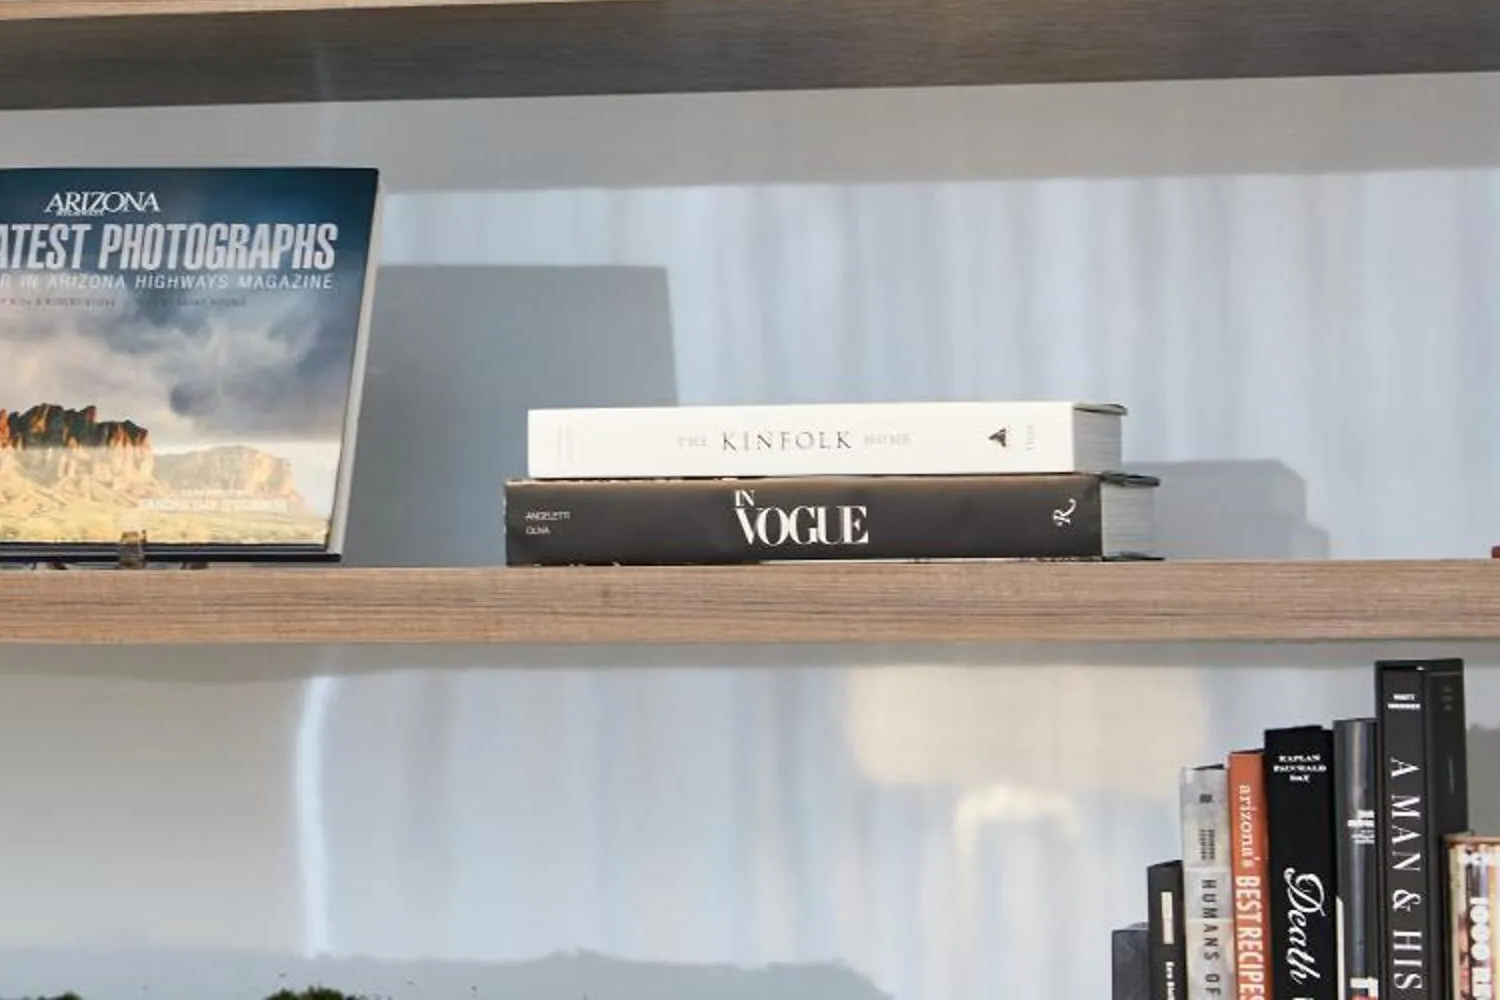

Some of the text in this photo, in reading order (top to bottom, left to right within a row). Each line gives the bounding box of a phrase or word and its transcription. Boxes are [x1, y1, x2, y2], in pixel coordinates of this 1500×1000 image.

[43, 191, 161, 213] ARIZONA
[97, 222, 339, 271] PHOTOGRAPHS
[20, 274, 39, 289] IN
[46, 273, 126, 290] ARIZONA
[134, 274, 229, 290] HIGHWAYS
[238, 273, 334, 290] MAGAZINE
[722, 431, 852, 451] KINFOLK
[734, 489, 755, 507] IN
[734, 505, 869, 546] VOGUE
[1239, 784, 1261, 869] arizona's
[1390, 756, 1422, 989] A MAN & HIS
[1202, 879, 1220, 960] HUMANS
[1236, 875, 1263, 925] BEST
[1284, 867, 1327, 985] Death
[1205, 973, 1221, 997] OF
